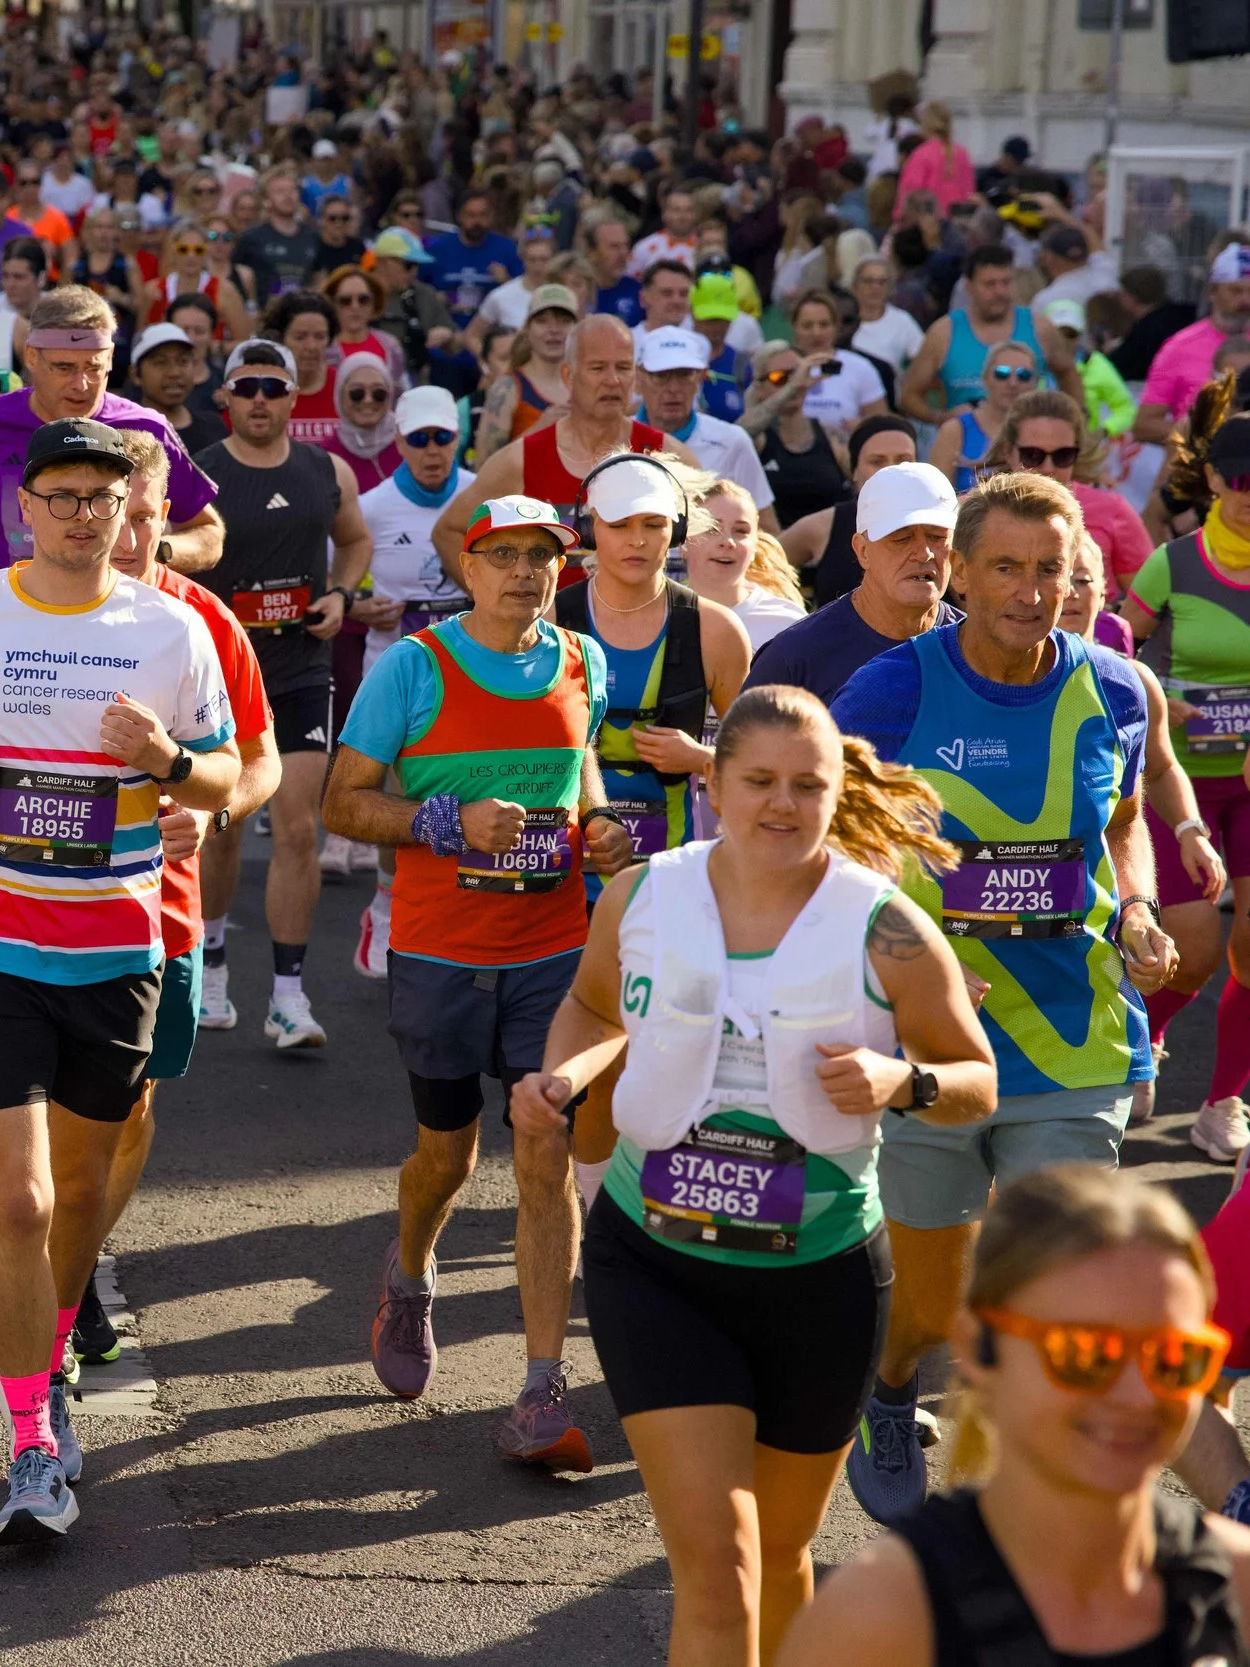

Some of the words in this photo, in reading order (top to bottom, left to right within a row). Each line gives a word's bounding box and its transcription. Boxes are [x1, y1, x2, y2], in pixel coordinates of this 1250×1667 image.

[262, 592, 292, 608] BEN
[256, 604, 299, 621] 19927
[5, 649, 78, 664] ymchwil
[81, 654, 140, 670] canser
[3, 666, 58, 681] cymru
[2, 684, 59, 698] cancer
[3, 700, 52, 715] wales
[967, 748, 1008, 756] VELINDRE
[470, 765, 494, 778] LES
[498, 762, 567, 777] CROUPIERS
[36, 775, 73, 786] CARDIFF
[73, 780, 97, 788] HALF
[505, 782, 555, 795] CARDIFF
[13, 795, 93, 819] ARCHIE
[609, 801, 631, 809] ARDIFF
[631, 801, 647, 809] HALF
[539, 813, 555, 821] HALF
[20, 816, 85, 840] 18955
[997, 845, 1037, 854] CARDIFF
[1039, 844, 1059, 853] HALF
[492, 852, 548, 870] 10691
[984, 868, 1051, 888] ANDY
[980, 891, 1054, 911] 22236
[697, 1129, 745, 1146] CARDIFF
[746, 1137, 777, 1151] HALF
[668, 1152, 773, 1191] STACEY
[670, 1181, 760, 1217] 25863
